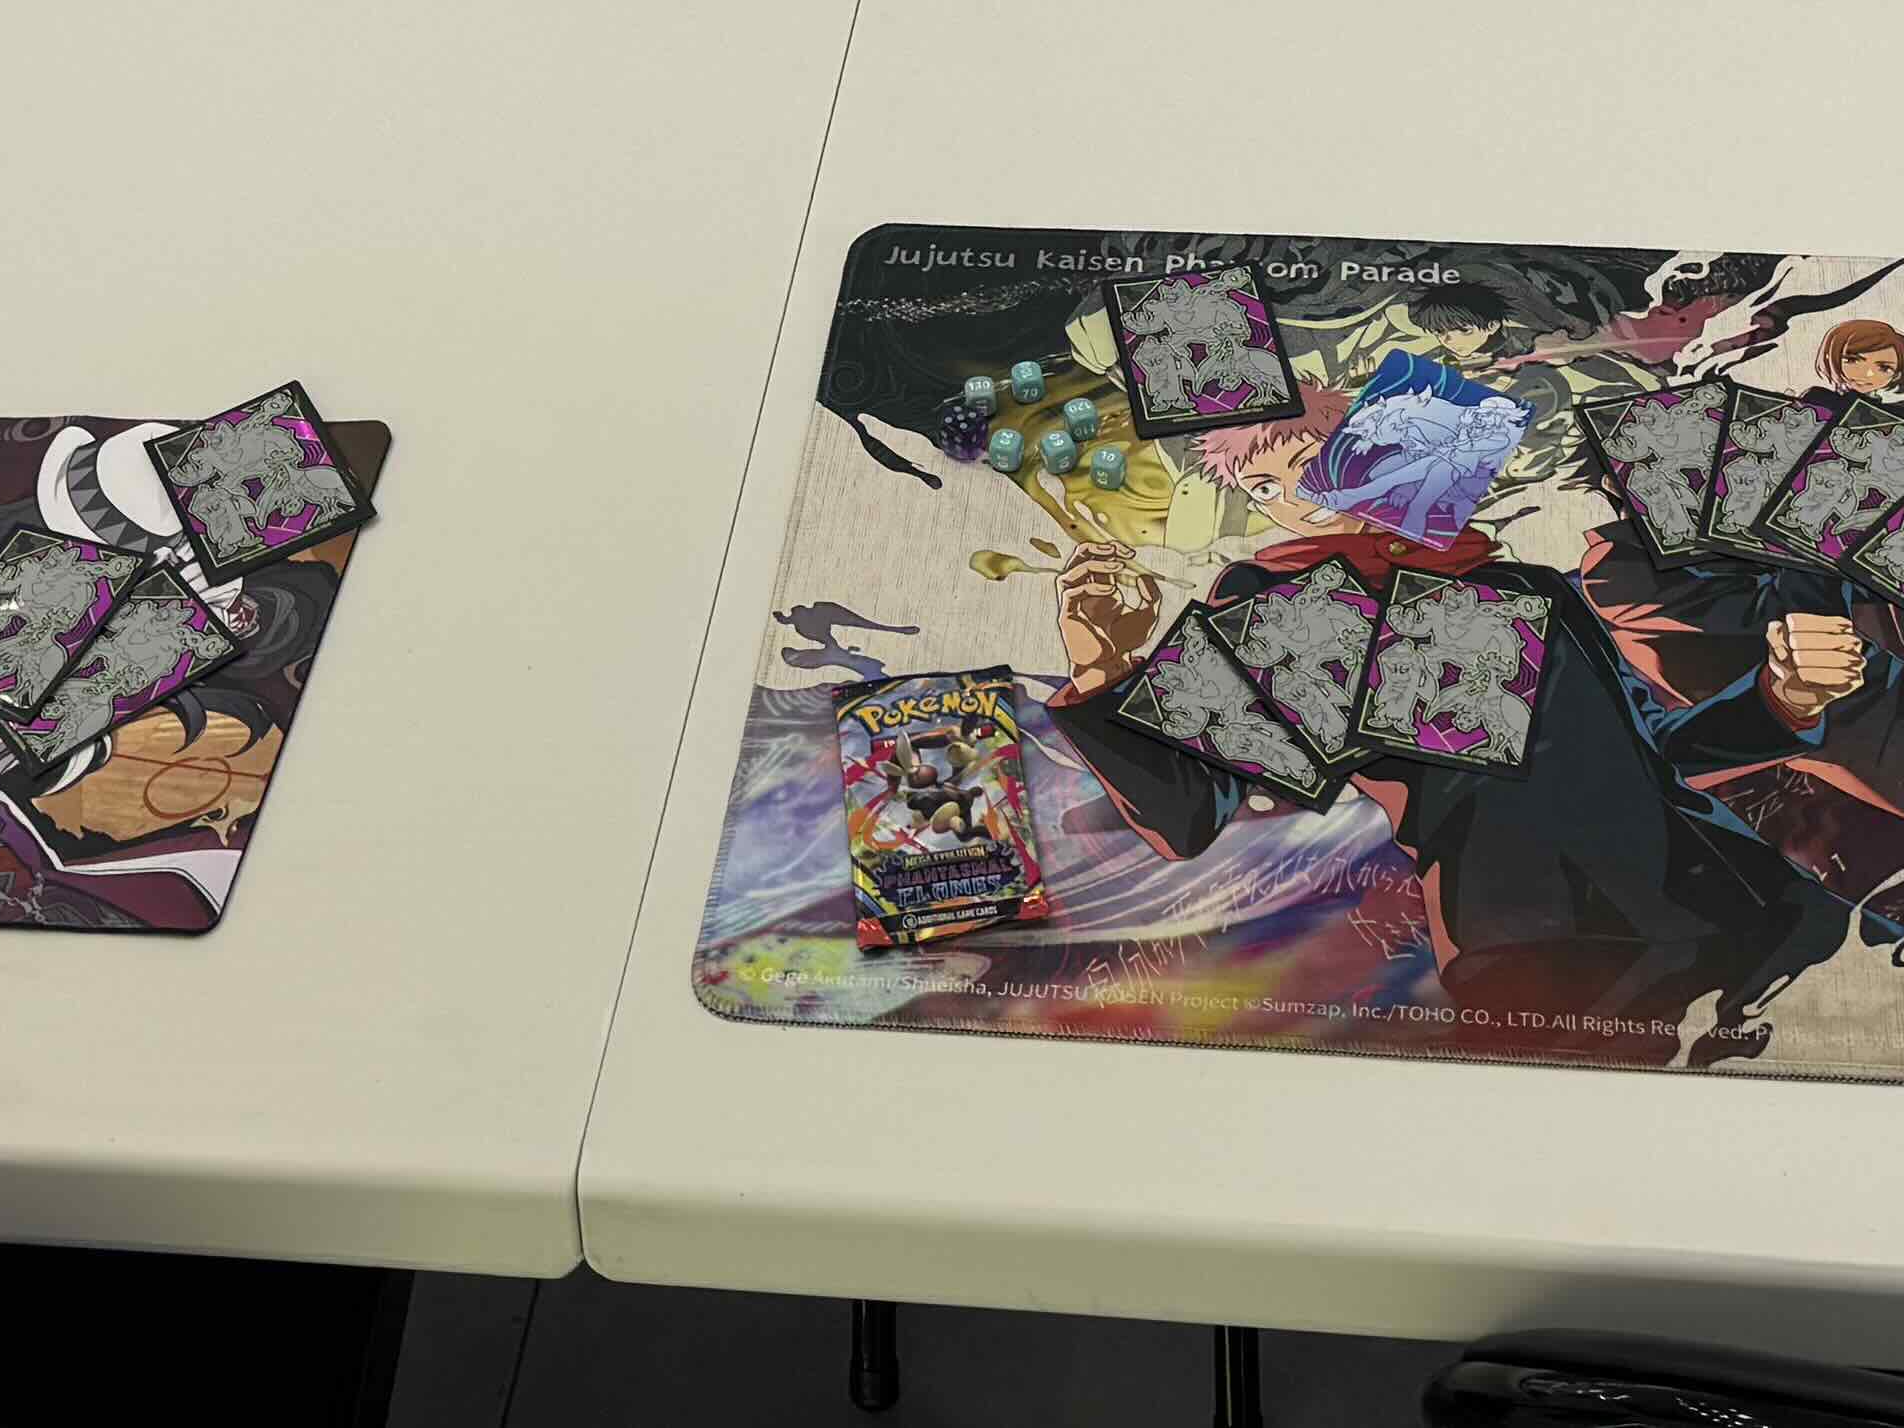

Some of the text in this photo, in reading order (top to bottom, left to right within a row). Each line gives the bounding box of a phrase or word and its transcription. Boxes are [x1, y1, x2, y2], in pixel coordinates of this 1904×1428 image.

[885, 244, 1462, 285] Jujutsu Kaisen Phom Parade
[760, 967, 809, 987] Gege
[996, 982, 1088, 1001] JUJUTSU
[1170, 994, 1239, 1012] Project
[1352, 1003, 1455, 1024] Inc./TOHO
[1460, 1008, 1502, 1028] CO.,
[1582, 1015, 1645, 1038] Rights
